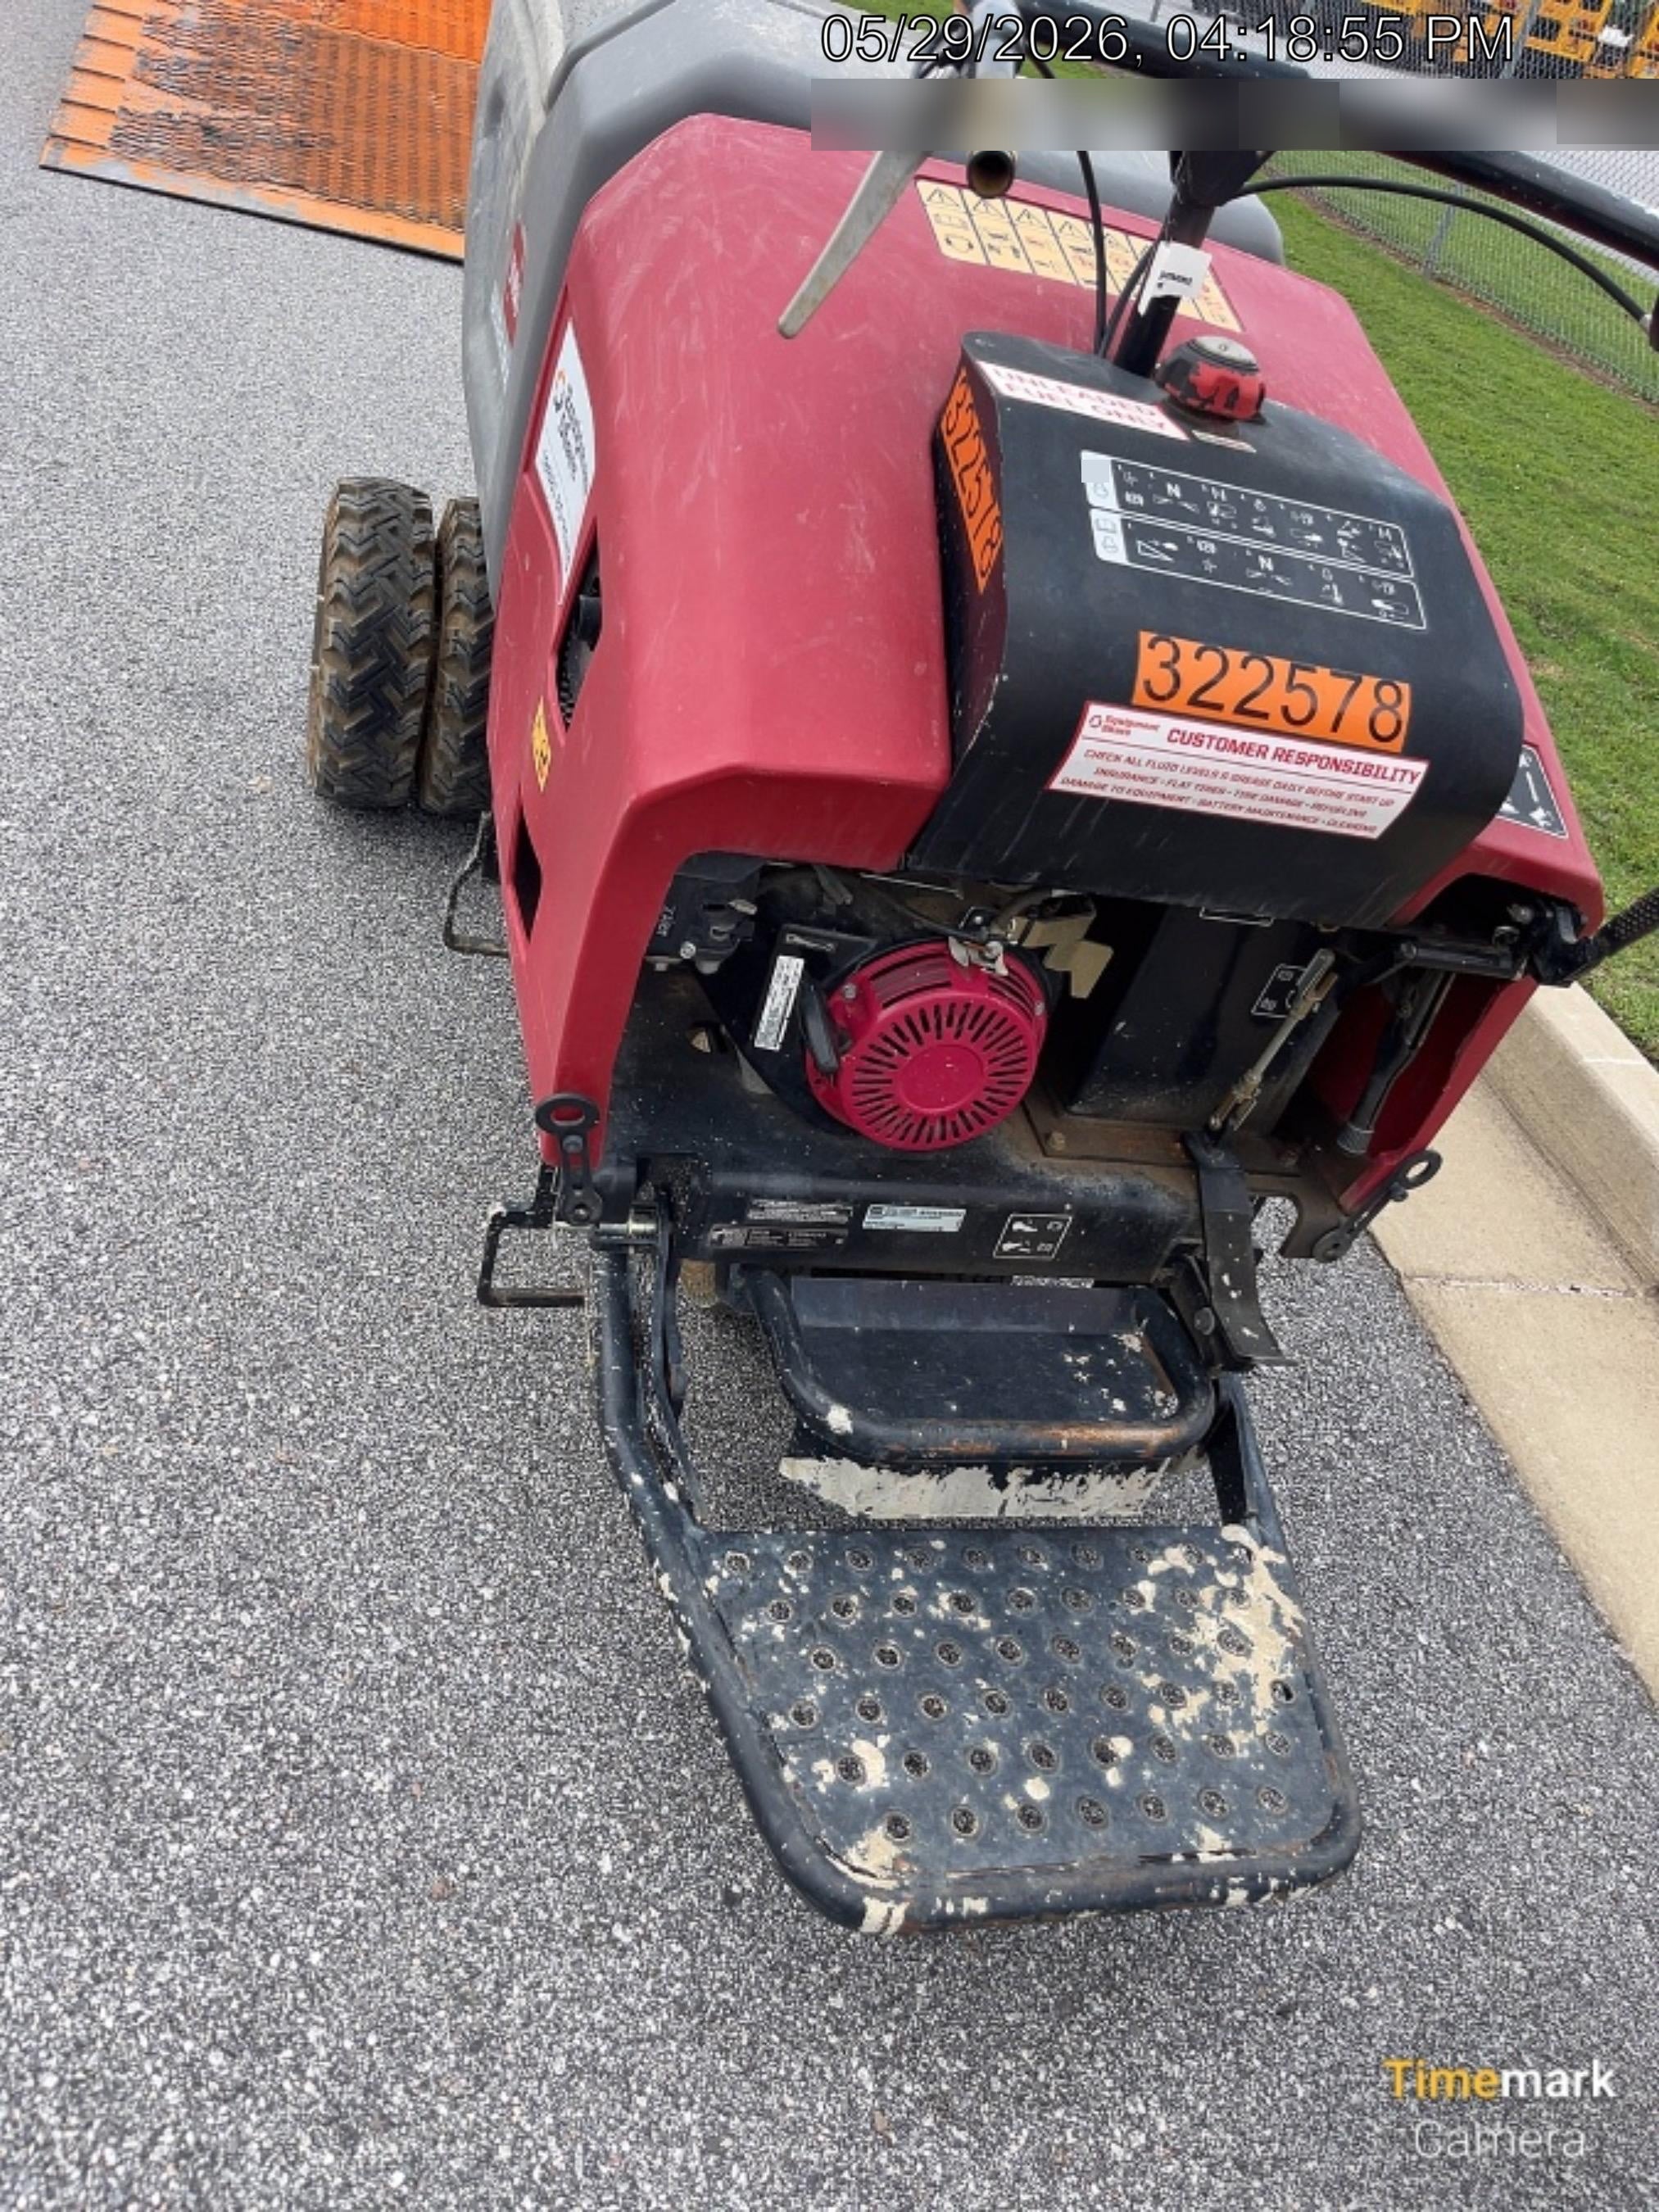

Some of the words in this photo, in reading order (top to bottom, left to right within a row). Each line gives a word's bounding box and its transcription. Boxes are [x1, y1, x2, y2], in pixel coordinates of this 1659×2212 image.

[992, 368, 1157, 417] UNLEADED
[1005, 382, 1077, 409] FUEL
[1090, 404, 1170, 430] ONLY
[1142, 634, 1404, 743] 322578
[1084, 749, 1122, 762] CHECK
[1123, 755, 1142, 767] ALL
[1272, 779, 1303, 792] DAILY
[1305, 786, 1344, 800] BEFORE
[1345, 792, 1378, 806] START
[1379, 799, 1395, 807] UP
[1167, 727, 1269, 759] CUSTOMER
[1271, 746, 1421, 784] RESPONSIBILITY
